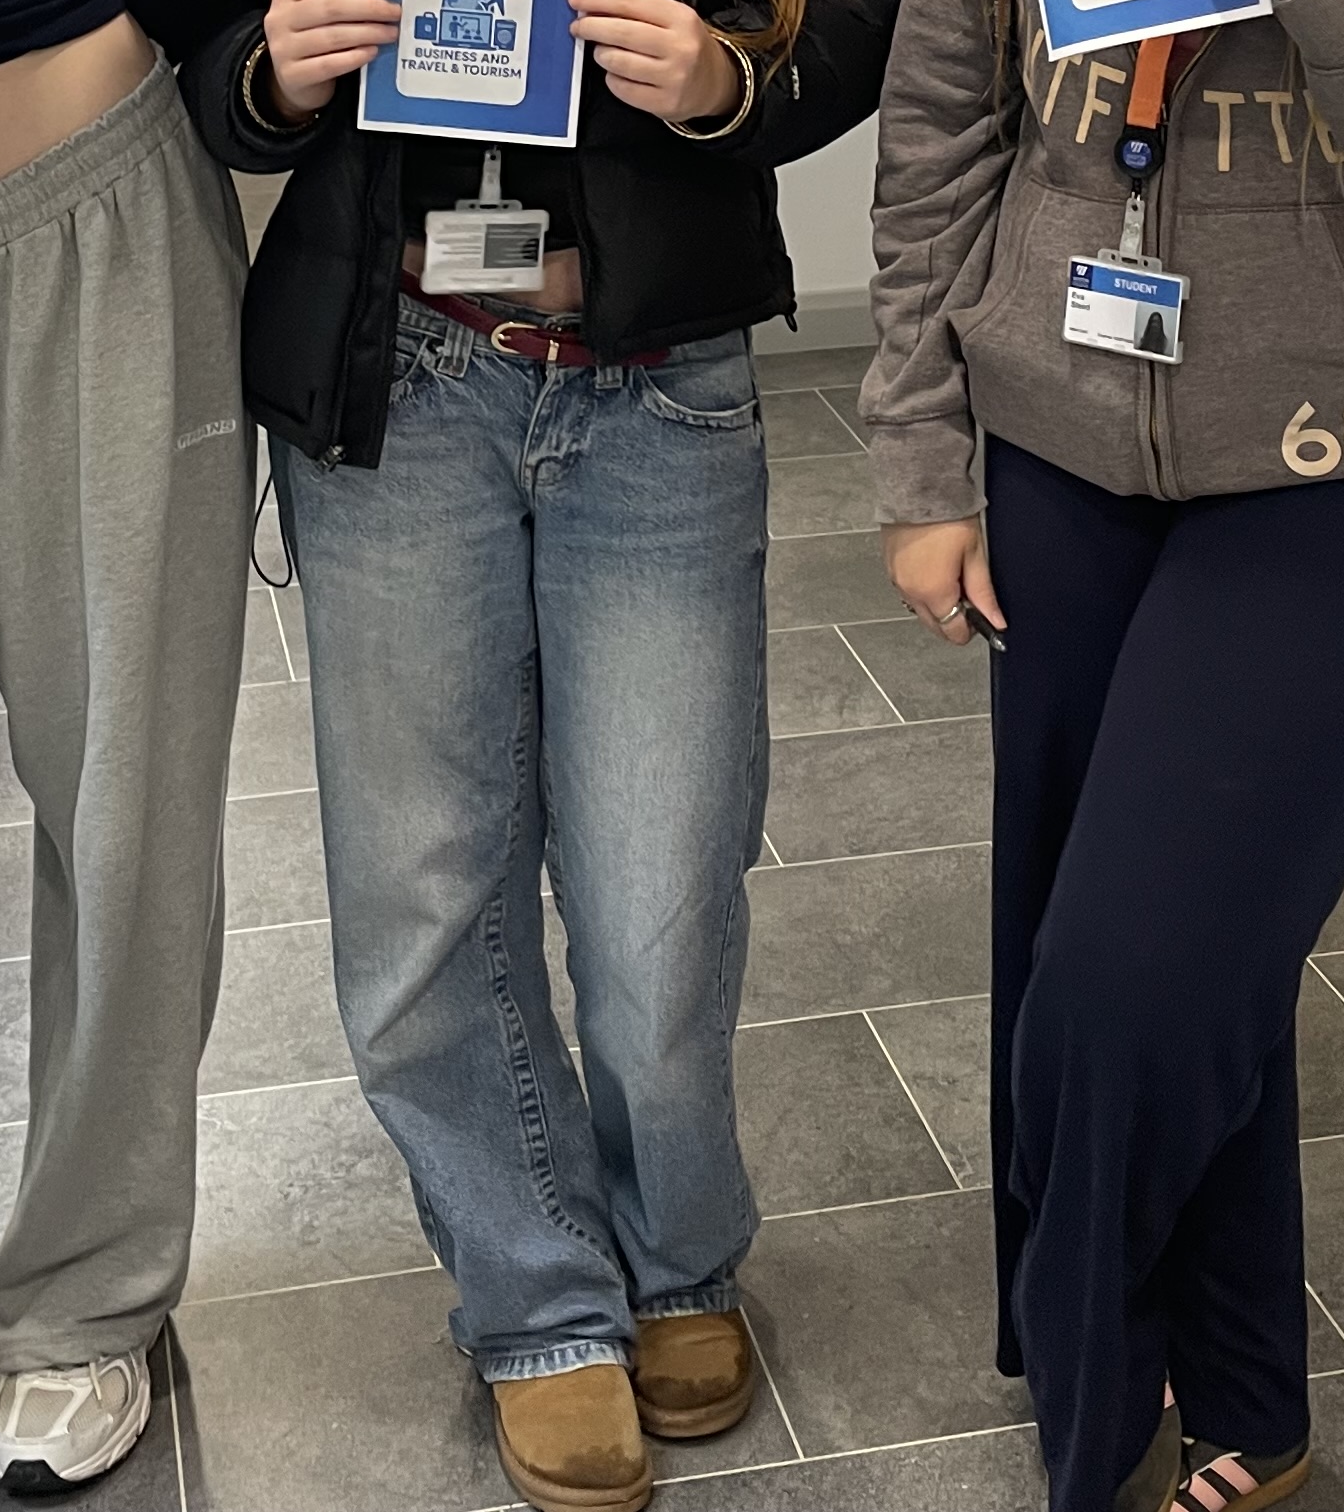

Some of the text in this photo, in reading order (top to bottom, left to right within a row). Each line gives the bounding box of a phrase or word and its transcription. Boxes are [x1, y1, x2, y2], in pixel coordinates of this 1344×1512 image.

[415, 47, 510, 64] BUSINESS AND
[401, 59, 522, 79] TRAVEL & TOURISM
[1114, 278, 1158, 295] STUDENT
